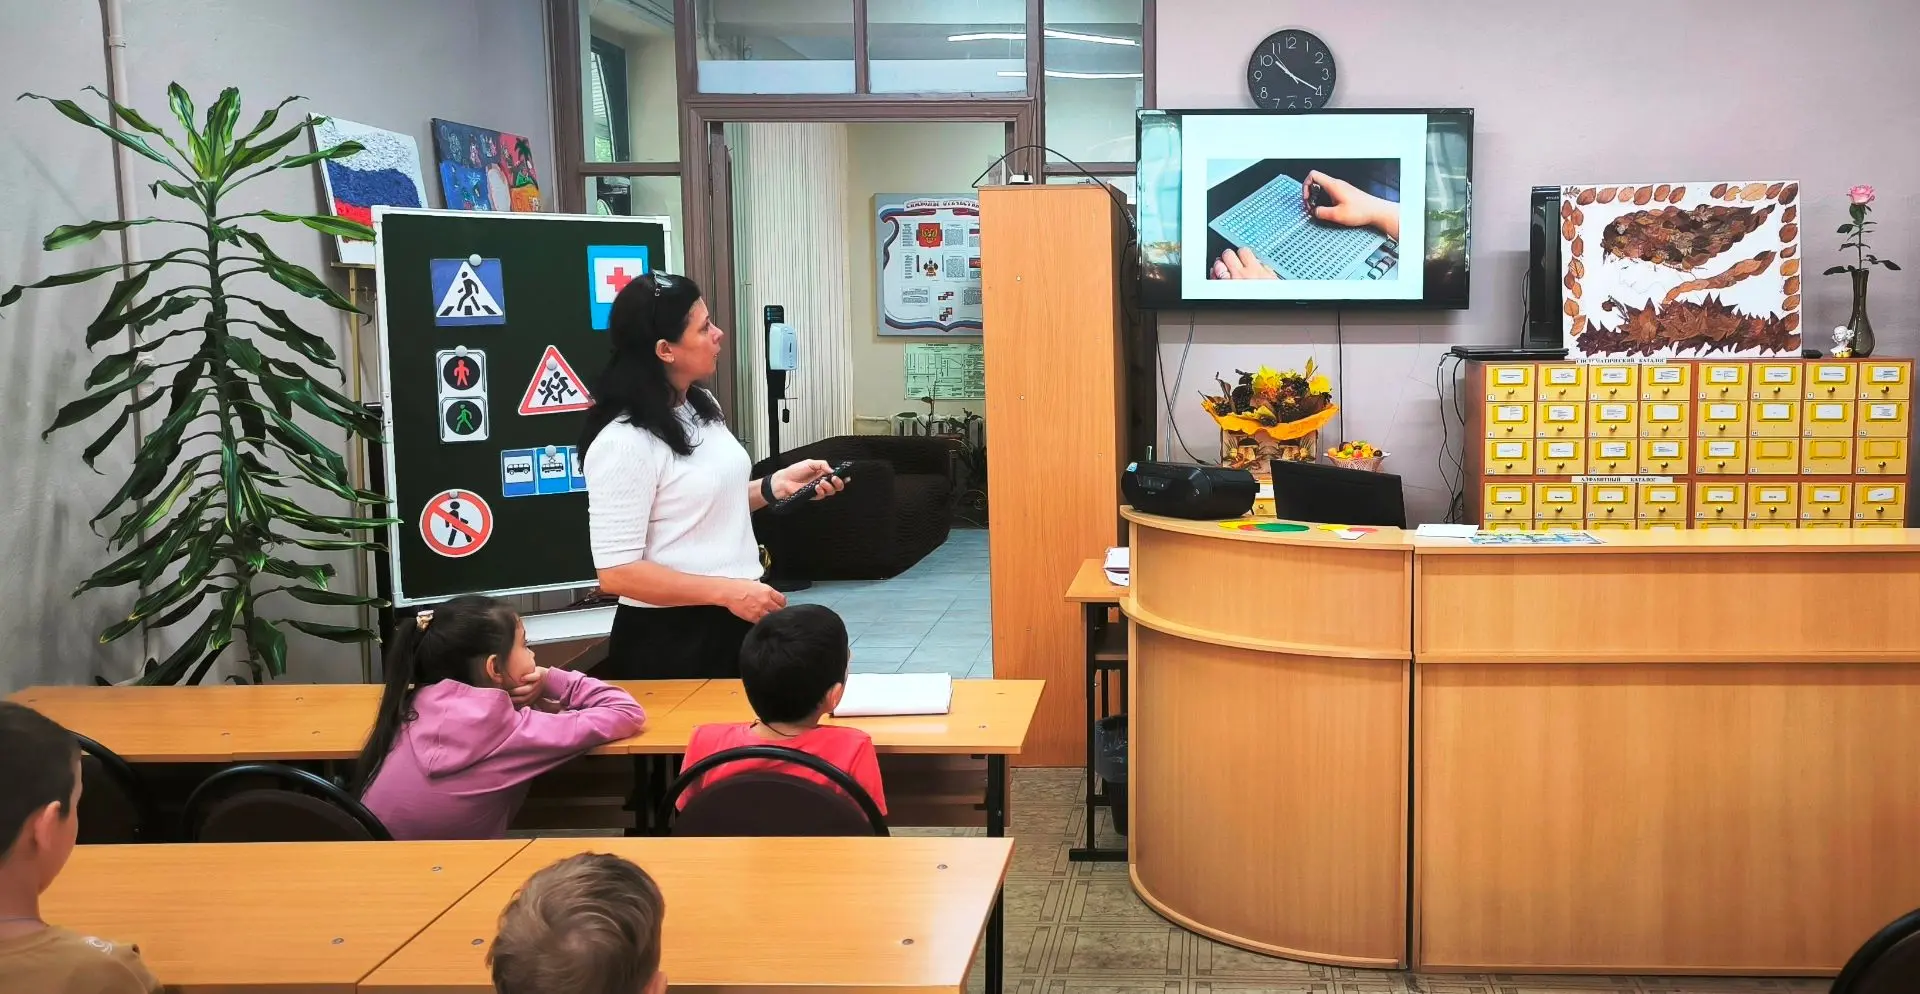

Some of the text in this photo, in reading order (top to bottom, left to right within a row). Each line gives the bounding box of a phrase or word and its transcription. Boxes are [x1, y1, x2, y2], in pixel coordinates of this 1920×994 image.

[1272, 43, 1281, 54] 11
[1286, 36, 1297, 49] 12
[1260, 55, 1273, 67] 10
[1315, 52, 1323, 64] 2
[1254, 71, 1263, 82] 9
[1322, 68, 1329, 81] 3
[1260, 87, 1268, 99] 8
[1315, 85, 1322, 96] 4
[1272, 98, 1281, 109] 7
[1304, 97, 1313, 109] 5
